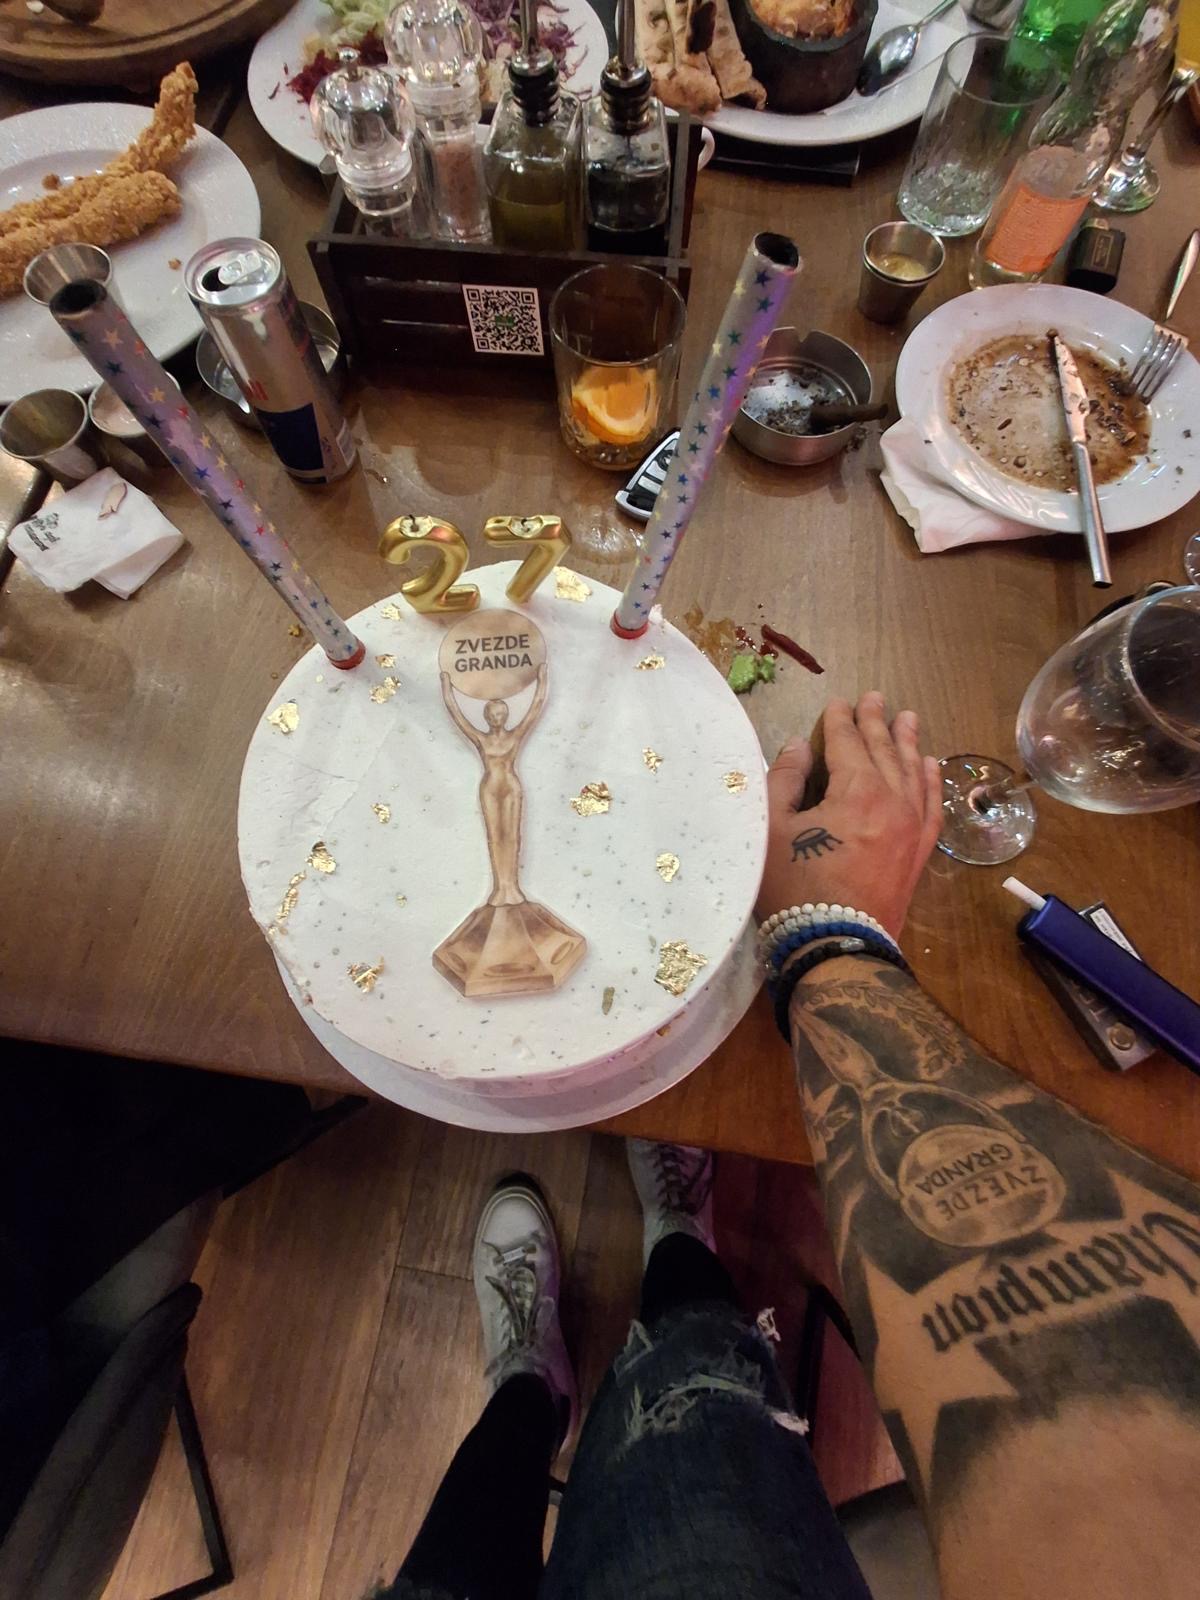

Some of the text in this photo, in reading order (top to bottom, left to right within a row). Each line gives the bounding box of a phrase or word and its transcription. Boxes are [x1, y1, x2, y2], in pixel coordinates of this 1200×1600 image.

[378, 514, 572, 613] 27
[454, 633, 530, 655] ZVEZDE
[454, 652, 533, 674] GRANDA
[916, 1143, 1013, 1195] GRANDA
[937, 1166, 1047, 1221] ZVEZDE
